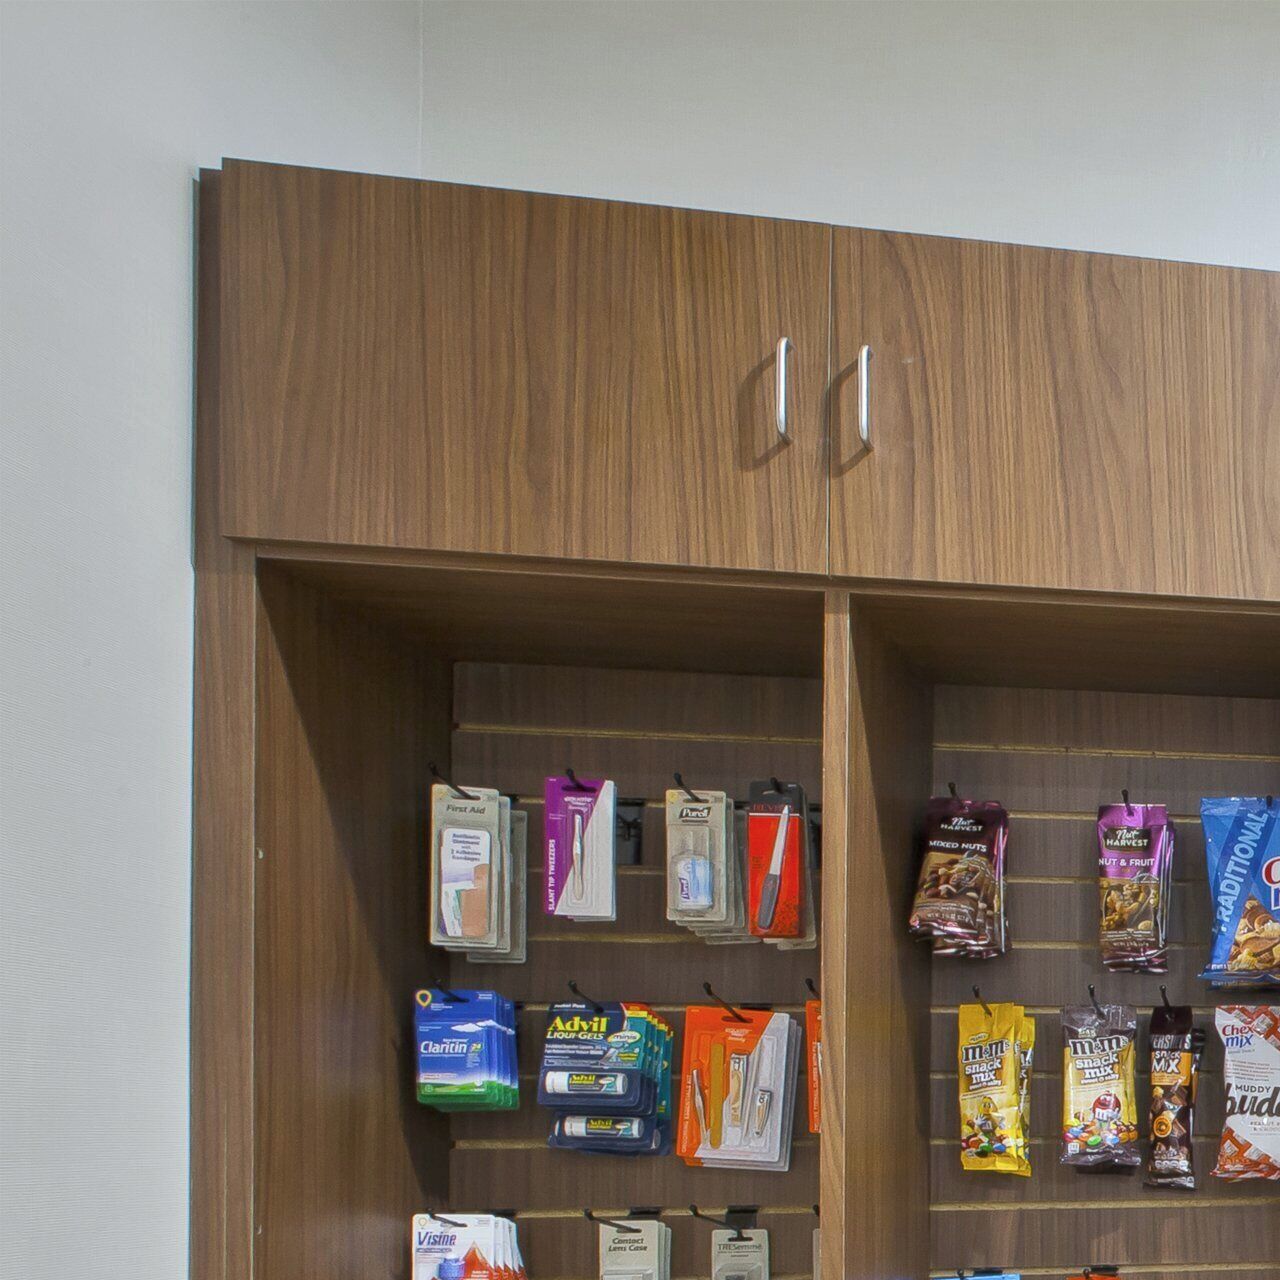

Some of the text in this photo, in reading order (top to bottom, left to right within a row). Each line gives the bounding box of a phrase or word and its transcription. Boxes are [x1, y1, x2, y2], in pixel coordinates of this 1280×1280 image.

[446, 804, 486, 815] First Aid
[952, 816, 975, 827] Nut
[940, 824, 983, 832] HARVEST
[1116, 829, 1139, 839] Nut
[929, 840, 988, 852] MIXED NUTS
[1106, 838, 1148, 847] HARVEST
[1098, 858, 1155, 867] NUT & FRUIT
[548, 874, 556, 885] TIP
[548, 886, 556, 911] SLANT
[548, 1016, 609, 1032] Advil
[1222, 1024, 1254, 1036] Chex
[1225, 1034, 1253, 1048] mix
[420, 1041, 468, 1054] Claritin
[965, 1058, 1001, 1075] snack
[1075, 1052, 1118, 1070] snack
[972, 1071, 996, 1083] mix
[1084, 1065, 1113, 1078] mix
[1235, 1085, 1272, 1093] MUDDY
[417, 1231, 457, 1246] Visine
[612, 1237, 644, 1245] Contact
